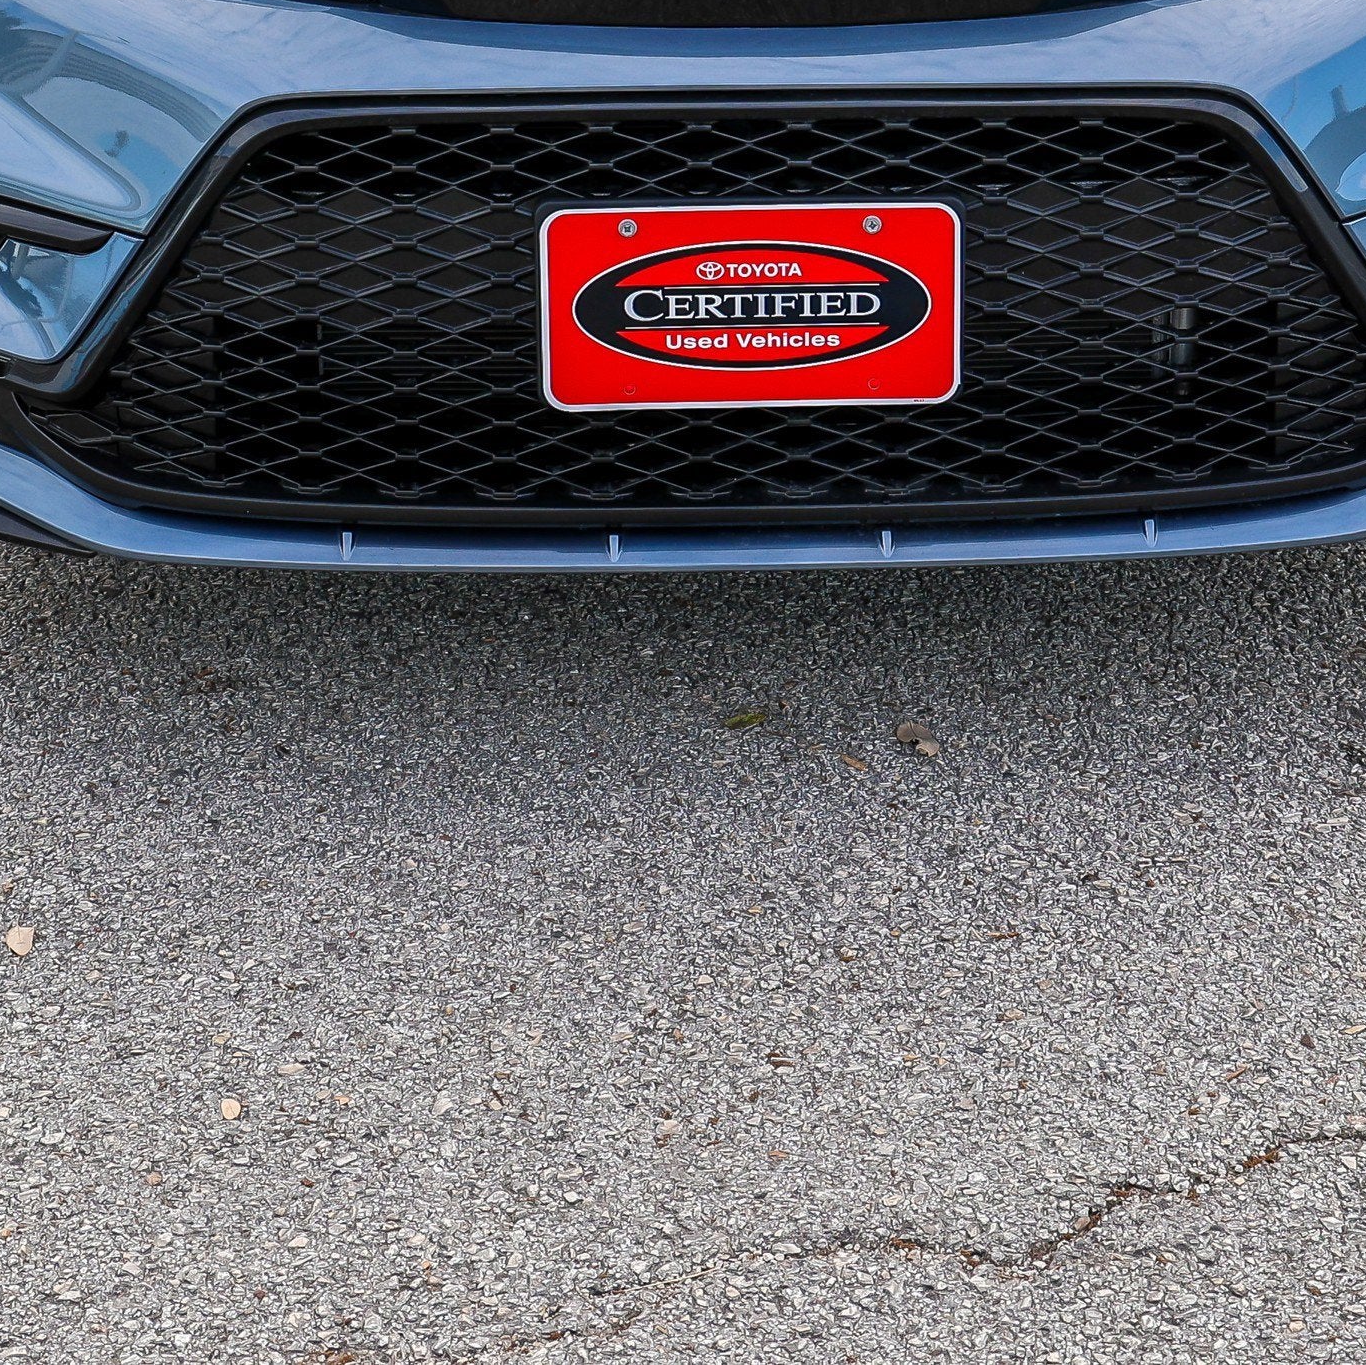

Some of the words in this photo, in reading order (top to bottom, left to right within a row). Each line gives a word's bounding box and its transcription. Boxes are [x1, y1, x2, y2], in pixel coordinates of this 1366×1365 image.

[726, 262, 802, 278] TOYOTA
[623, 288, 882, 322] CERTIFIED
[665, 333, 729, 350] Used
[736, 332, 841, 349] Vehicles
